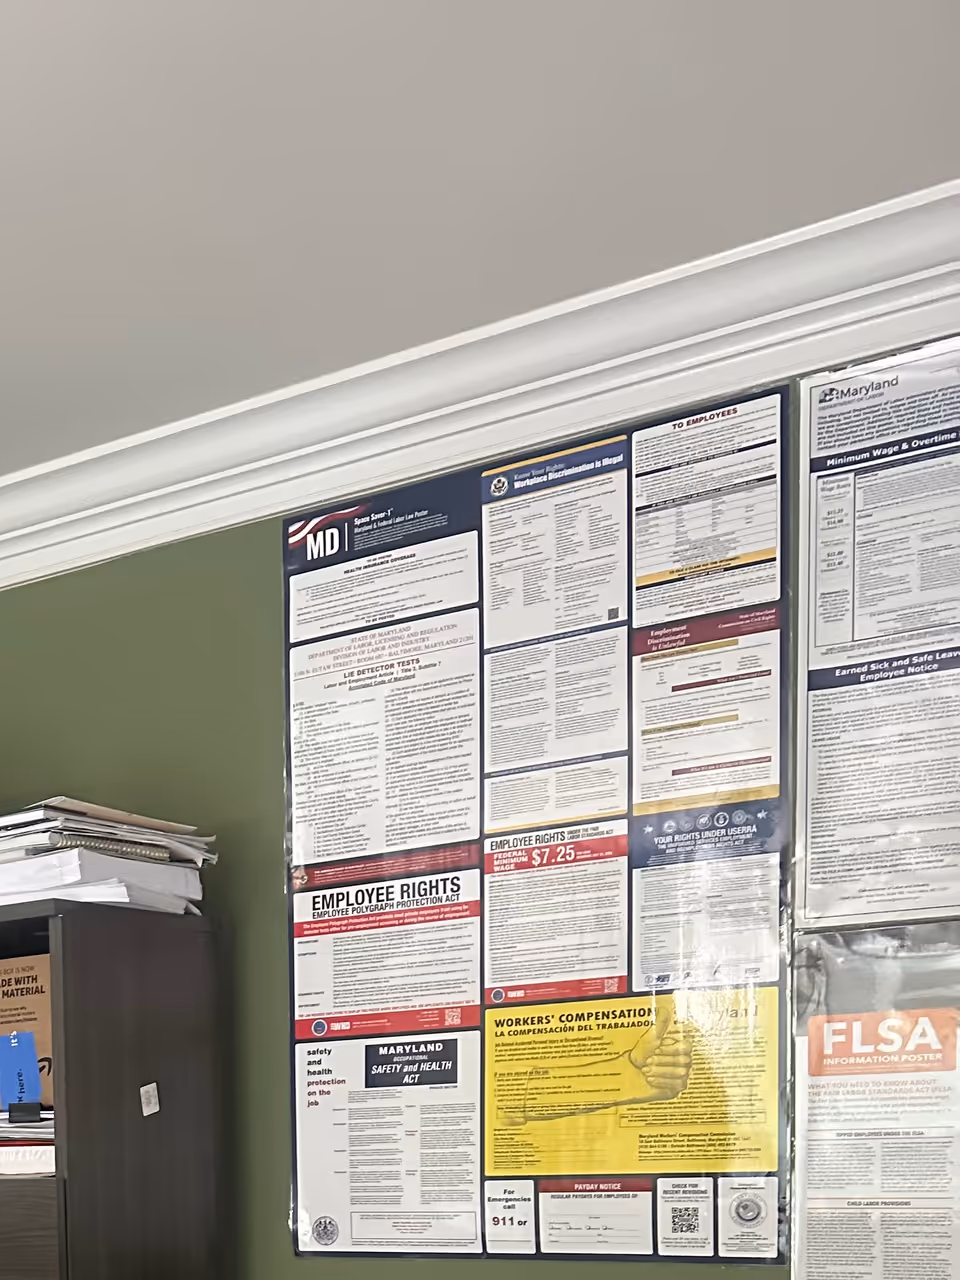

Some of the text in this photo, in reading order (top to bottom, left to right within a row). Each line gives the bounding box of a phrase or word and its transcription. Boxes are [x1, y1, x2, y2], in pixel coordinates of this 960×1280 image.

[840, 375, 899, 399] Maryland
[686, 408, 738, 427] EMPLOYEES
[827, 452, 869, 466] Minimum
[872, 444, 899, 456] Wage
[912, 432, 956, 447] Overtime
[514, 454, 623, 489] Workplace Discrimination is Illegal
[354, 517, 369, 525] Space
[306, 527, 339, 561] MD
[390, 553, 416, 563] COVERAGE
[351, 634, 368, 643] STATE
[377, 626, 411, 638] MARYLAND
[651, 626, 687, 637] Employment
[308, 648, 342, 660] DEPARTMENT
[408, 632, 419, 640] AND
[420, 624, 457, 637] REGULATION
[648, 632, 690, 645] Discrimination
[658, 640, 685, 650] Unlawful
[333, 652, 354, 661] DIVISION
[367, 645, 386, 655] LABOR
[402, 636, 430, 648] INDUSTRY
[344, 658, 420, 678] LIE DETECTOR TESTS
[836, 650, 960, 676] Earned Sick and Safe Leav
[860, 664, 939, 681] Employee Notice
[654, 824, 757, 844] YOUR RIGHTS UNDER USERRA
[490, 837, 533, 851] EMPLOYEE
[535, 831, 565, 844] RIGHTS
[494, 850, 527, 859] FEDERAL
[494, 856, 528, 865] MINIMUM
[532, 845, 575, 866] $7.25
[493, 864, 515, 872] WAGE
[312, 876, 461, 911] EMPLOYEE RIGHTS
[312, 893, 460, 919] EMPLOYEE POLYGRAPH PROTECTION ACT
[14, 975, 37, 985] WITH
[2, 985, 45, 998] MATERIAL
[494, 1007, 656, 1028] WORKERS' COMPENSATION
[508, 1023, 574, 1036] COMPENSACIÓN
[824, 1016, 942, 1054] FLSA
[307, 1048, 331, 1056] safety
[379, 1043, 443, 1055] MARYLAND
[824, 1053, 942, 1065] INFORMATION POSTER
[308, 1068, 332, 1076] health
[372, 1061, 451, 1074] SAFETY and HEALTH
[17, 1069, 25, 1093] here.
[307, 1078, 346, 1087] protection
[403, 1073, 420, 1084] ACT
[307, 1100, 319, 1108] job
[492, 1216, 514, 1225] 911
